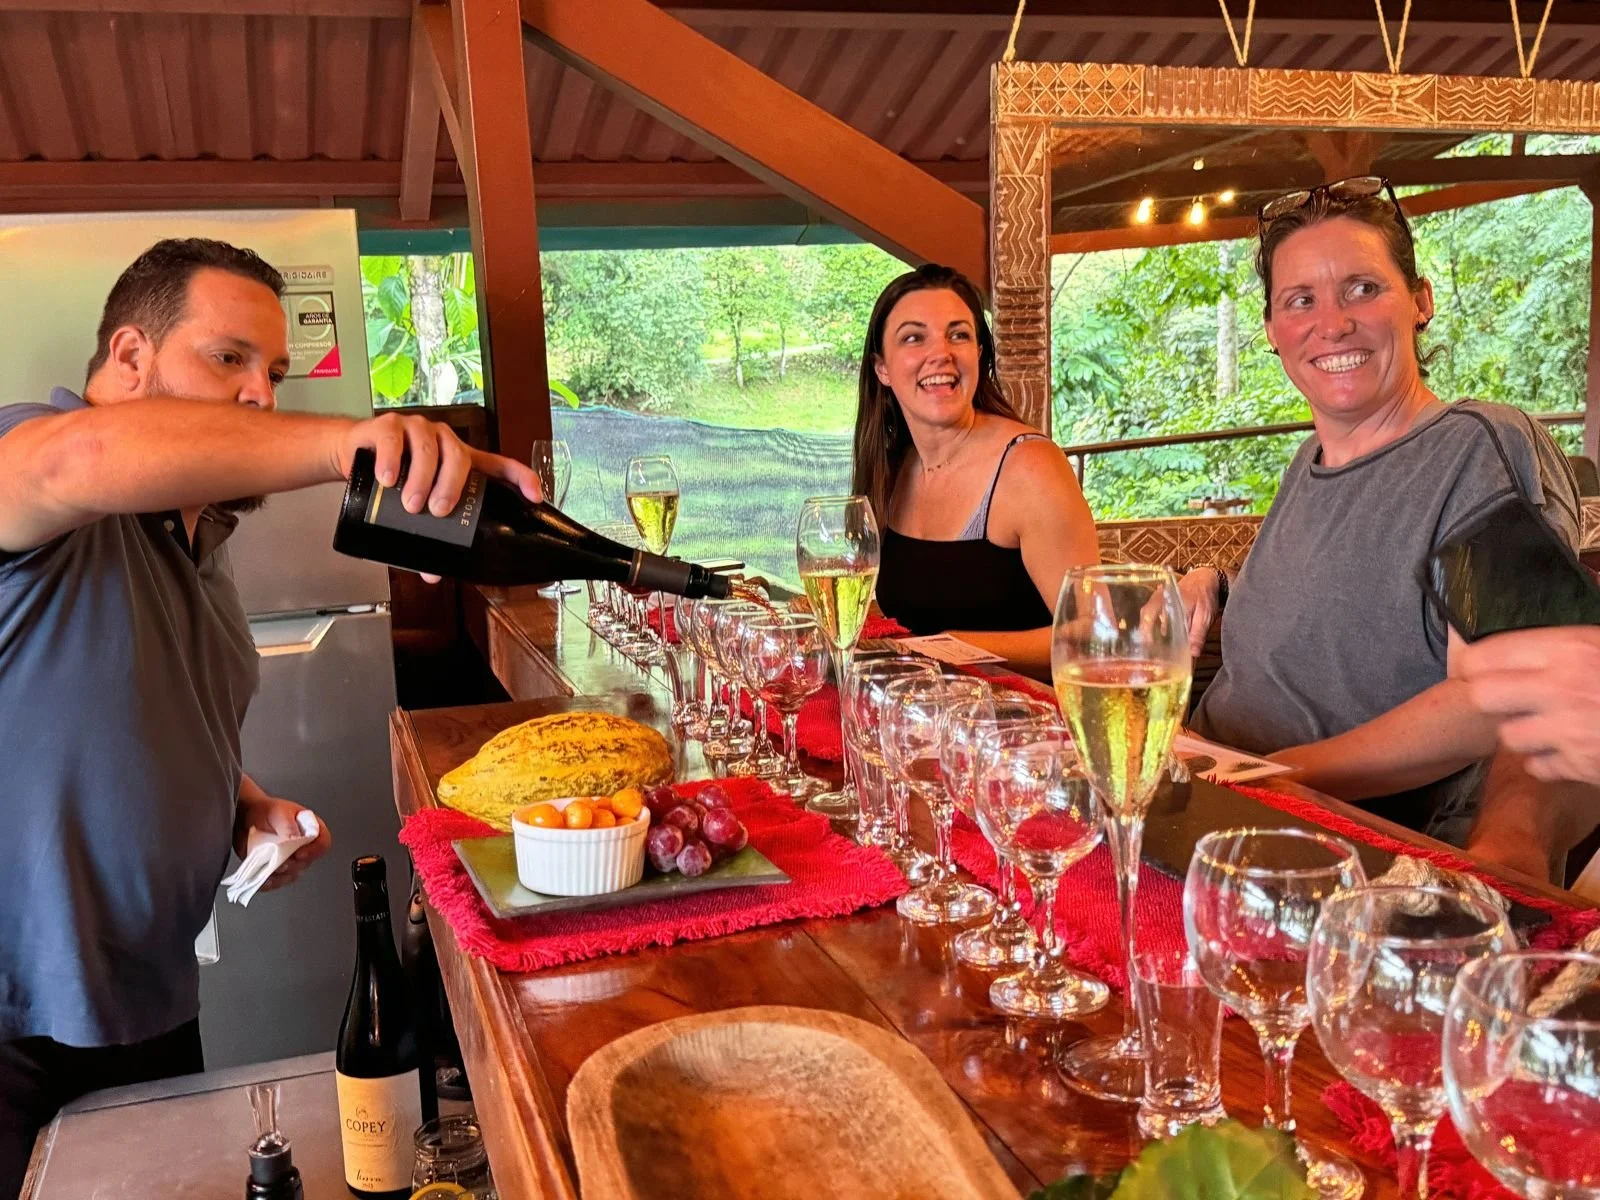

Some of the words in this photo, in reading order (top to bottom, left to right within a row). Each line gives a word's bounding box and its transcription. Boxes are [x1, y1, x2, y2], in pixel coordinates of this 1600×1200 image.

[281, 271, 327, 280] RIGIDAIRE
[460, 496, 477, 527] COLE
[346, 1118, 387, 1134] COPEY
